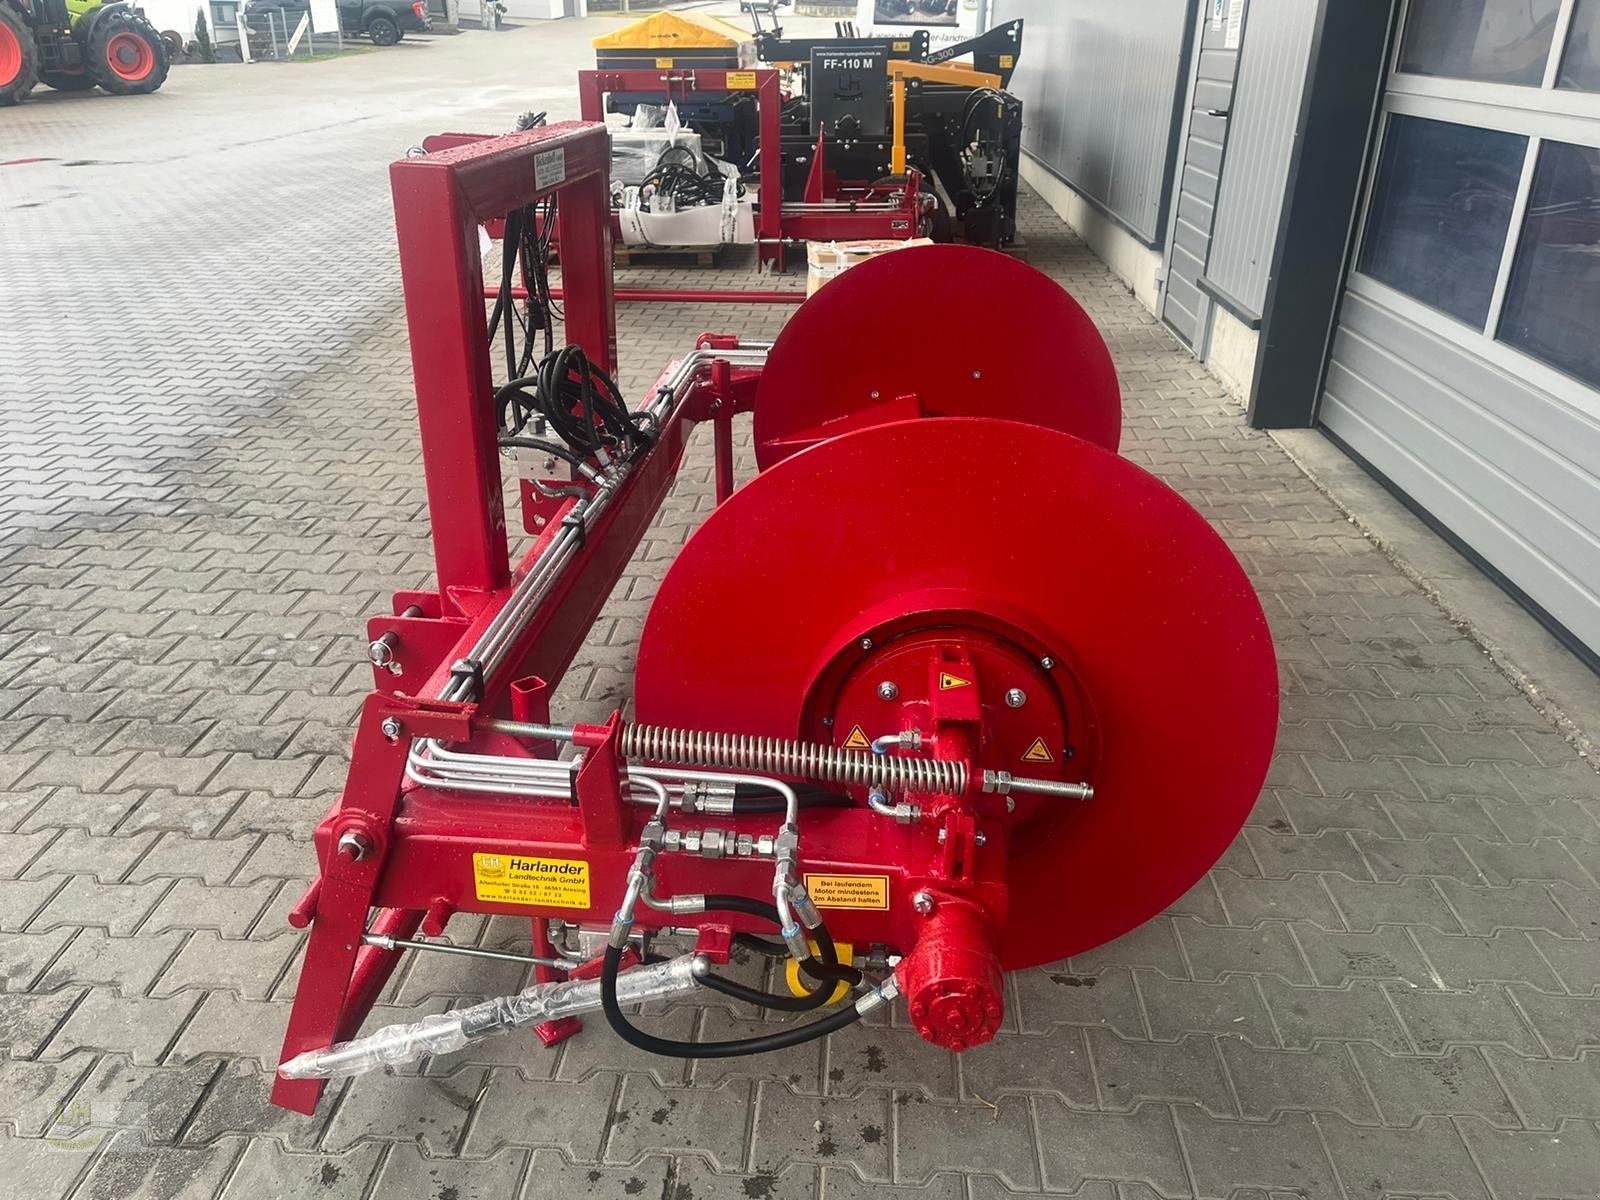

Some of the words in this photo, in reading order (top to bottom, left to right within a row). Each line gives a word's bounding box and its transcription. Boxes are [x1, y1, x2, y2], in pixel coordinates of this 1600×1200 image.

[824, 59, 860, 69] FF-110
[863, 58, 873, 68] M
[510, 859, 584, 875] Harlander
[509, 873, 557, 882] Landtechnik
[559, 876, 585, 884] GmbH
